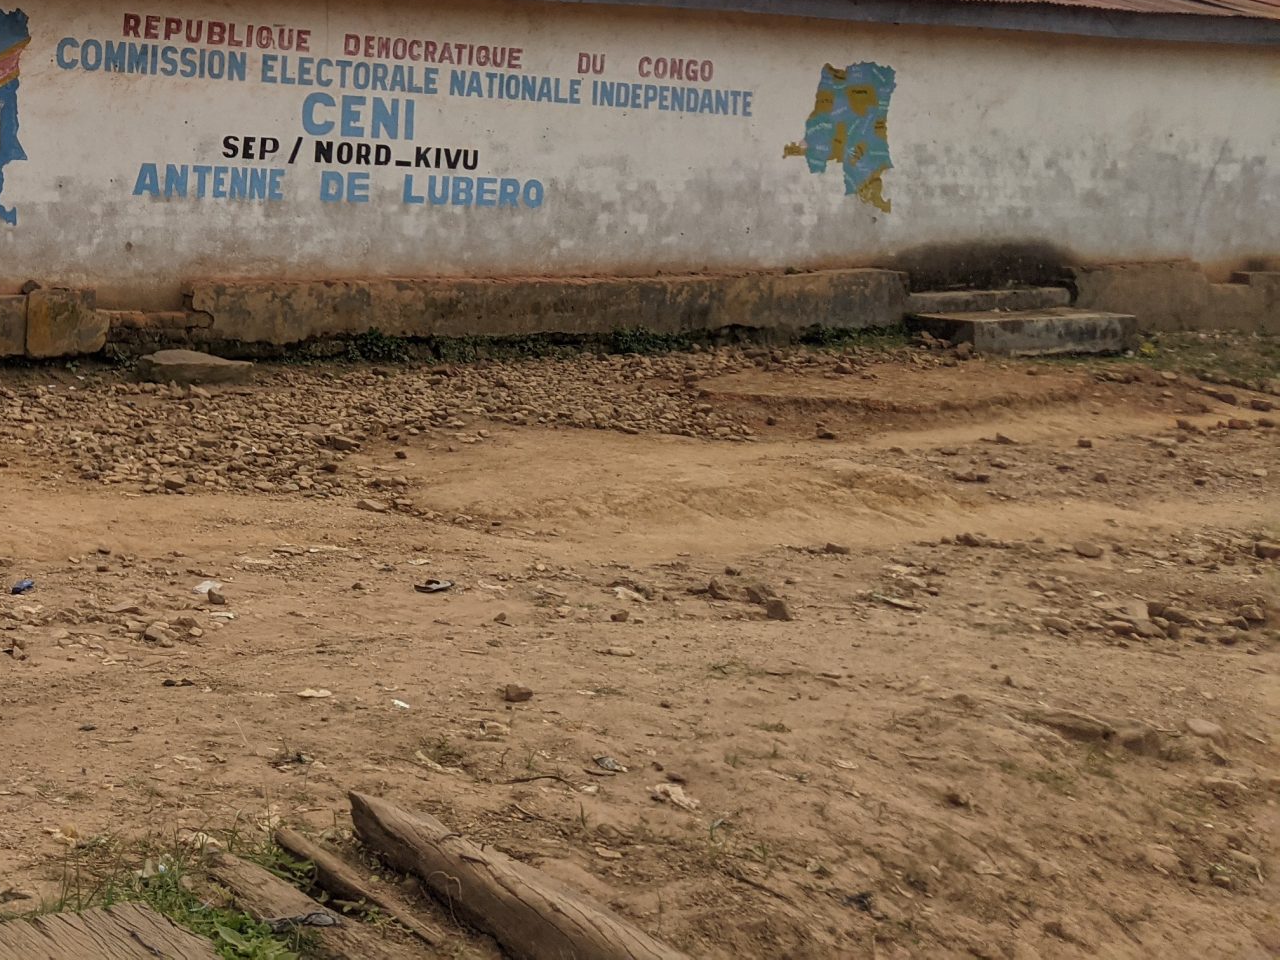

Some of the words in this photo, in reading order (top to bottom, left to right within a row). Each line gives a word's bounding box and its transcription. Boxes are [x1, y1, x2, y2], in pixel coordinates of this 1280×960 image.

[56, 37, 247, 81] COMMISSION
[261, 53, 439, 94] ELECTORALE
[449, 70, 581, 104] NATIONALE
[592, 80, 754, 117] INDEPENDANTE
[122, 13, 312, 53] REPUBLIQUE
[344, 33, 524, 69] DEMOCRATIQUE
[577, 52, 606, 75] DU
[638, 56, 714, 82] CONGO
[301, 92, 415, 141] CENI
[132, 163, 286, 200] ANTENNE
[320, 170, 370, 203] DE
[403, 174, 544, 208] LUBERO
